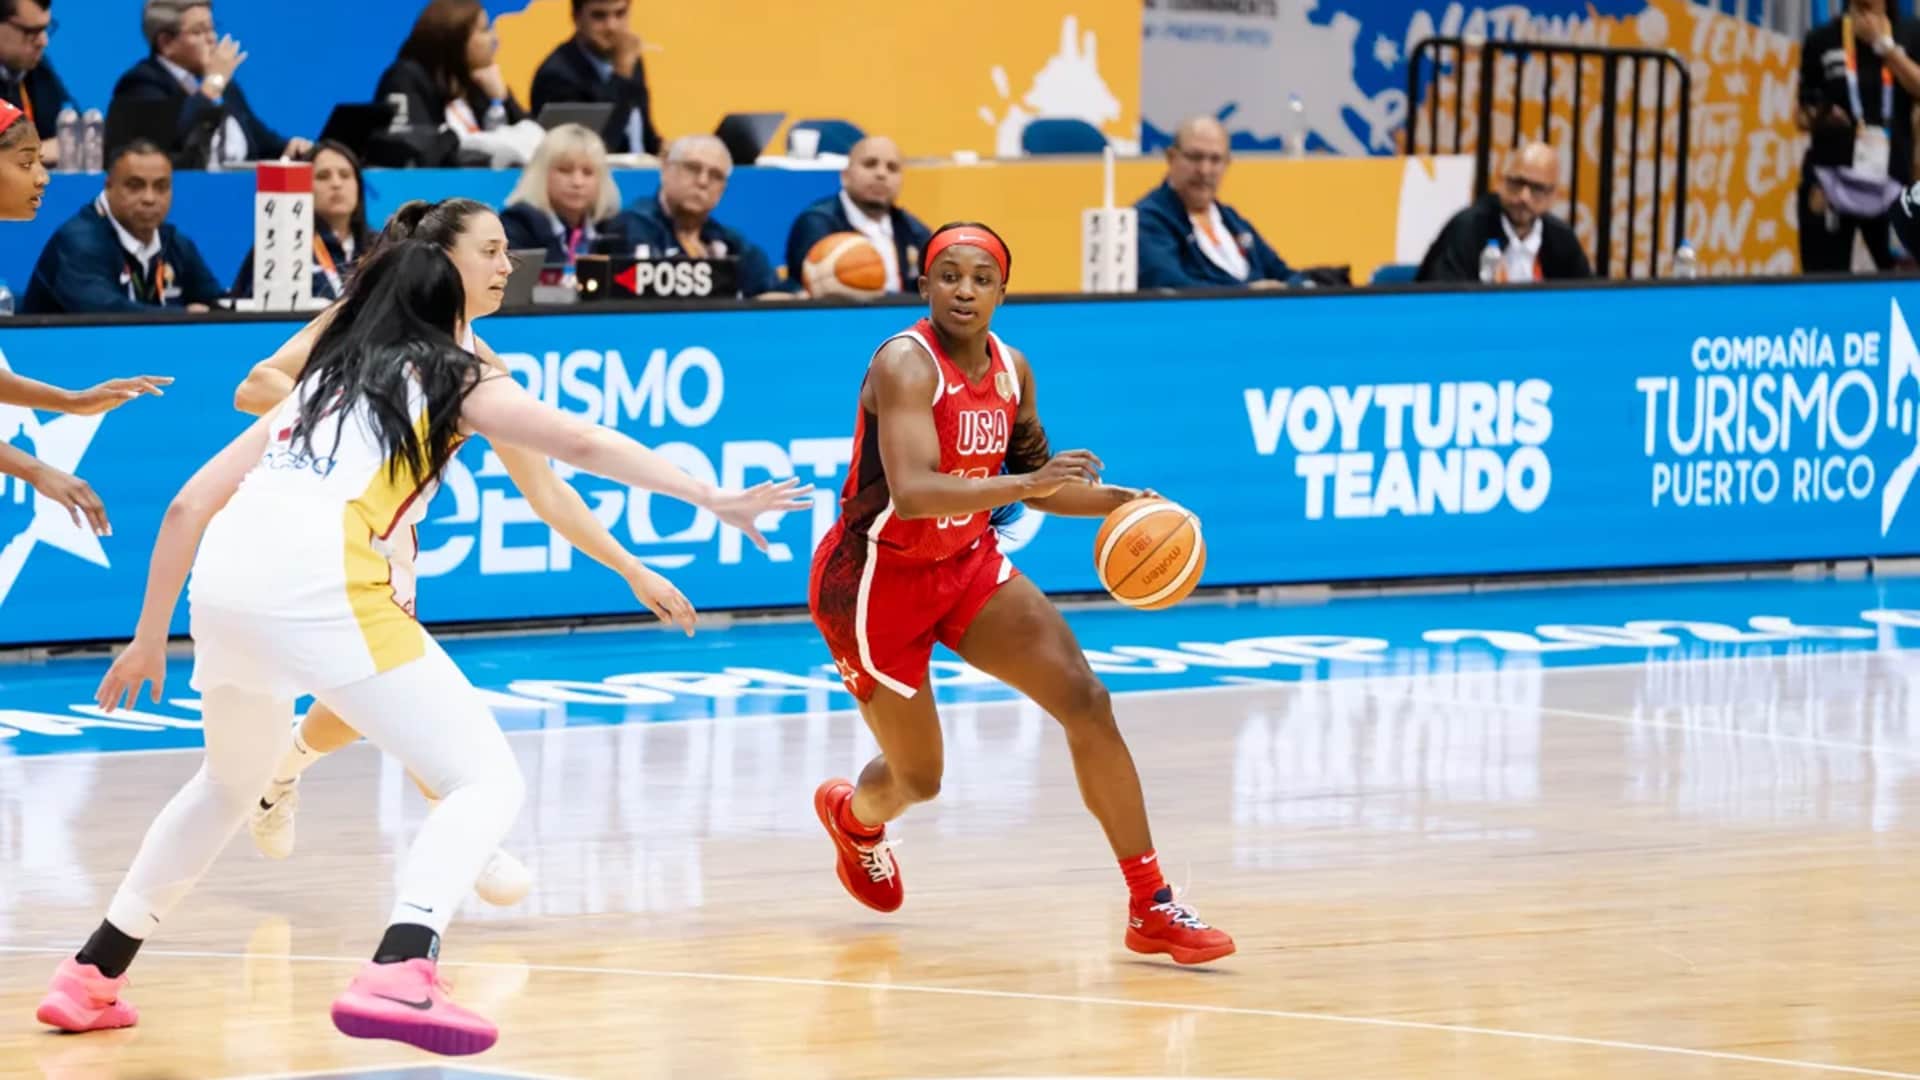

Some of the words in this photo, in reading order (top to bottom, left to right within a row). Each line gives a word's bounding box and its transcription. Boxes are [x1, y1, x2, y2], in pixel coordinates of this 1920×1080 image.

[264, 199, 275, 218] 4
[264, 259, 275, 280] 2
[292, 259, 303, 280] 2
[636, 261, 713, 297] POSS
[1691, 326, 1836, 371] COMPAÑÍA
[1843, 331, 1881, 367] DE
[956, 408, 1009, 456] USA
[1243, 378, 1553, 455] VOYTURIS
[1635, 369, 1880, 457] TURISMO
[1295, 446, 1552, 520] TEANDO
[1651, 458, 1780, 508] PUERTO
[1793, 455, 1875, 503] RICO
[1141, 545, 1181, 585] molten
